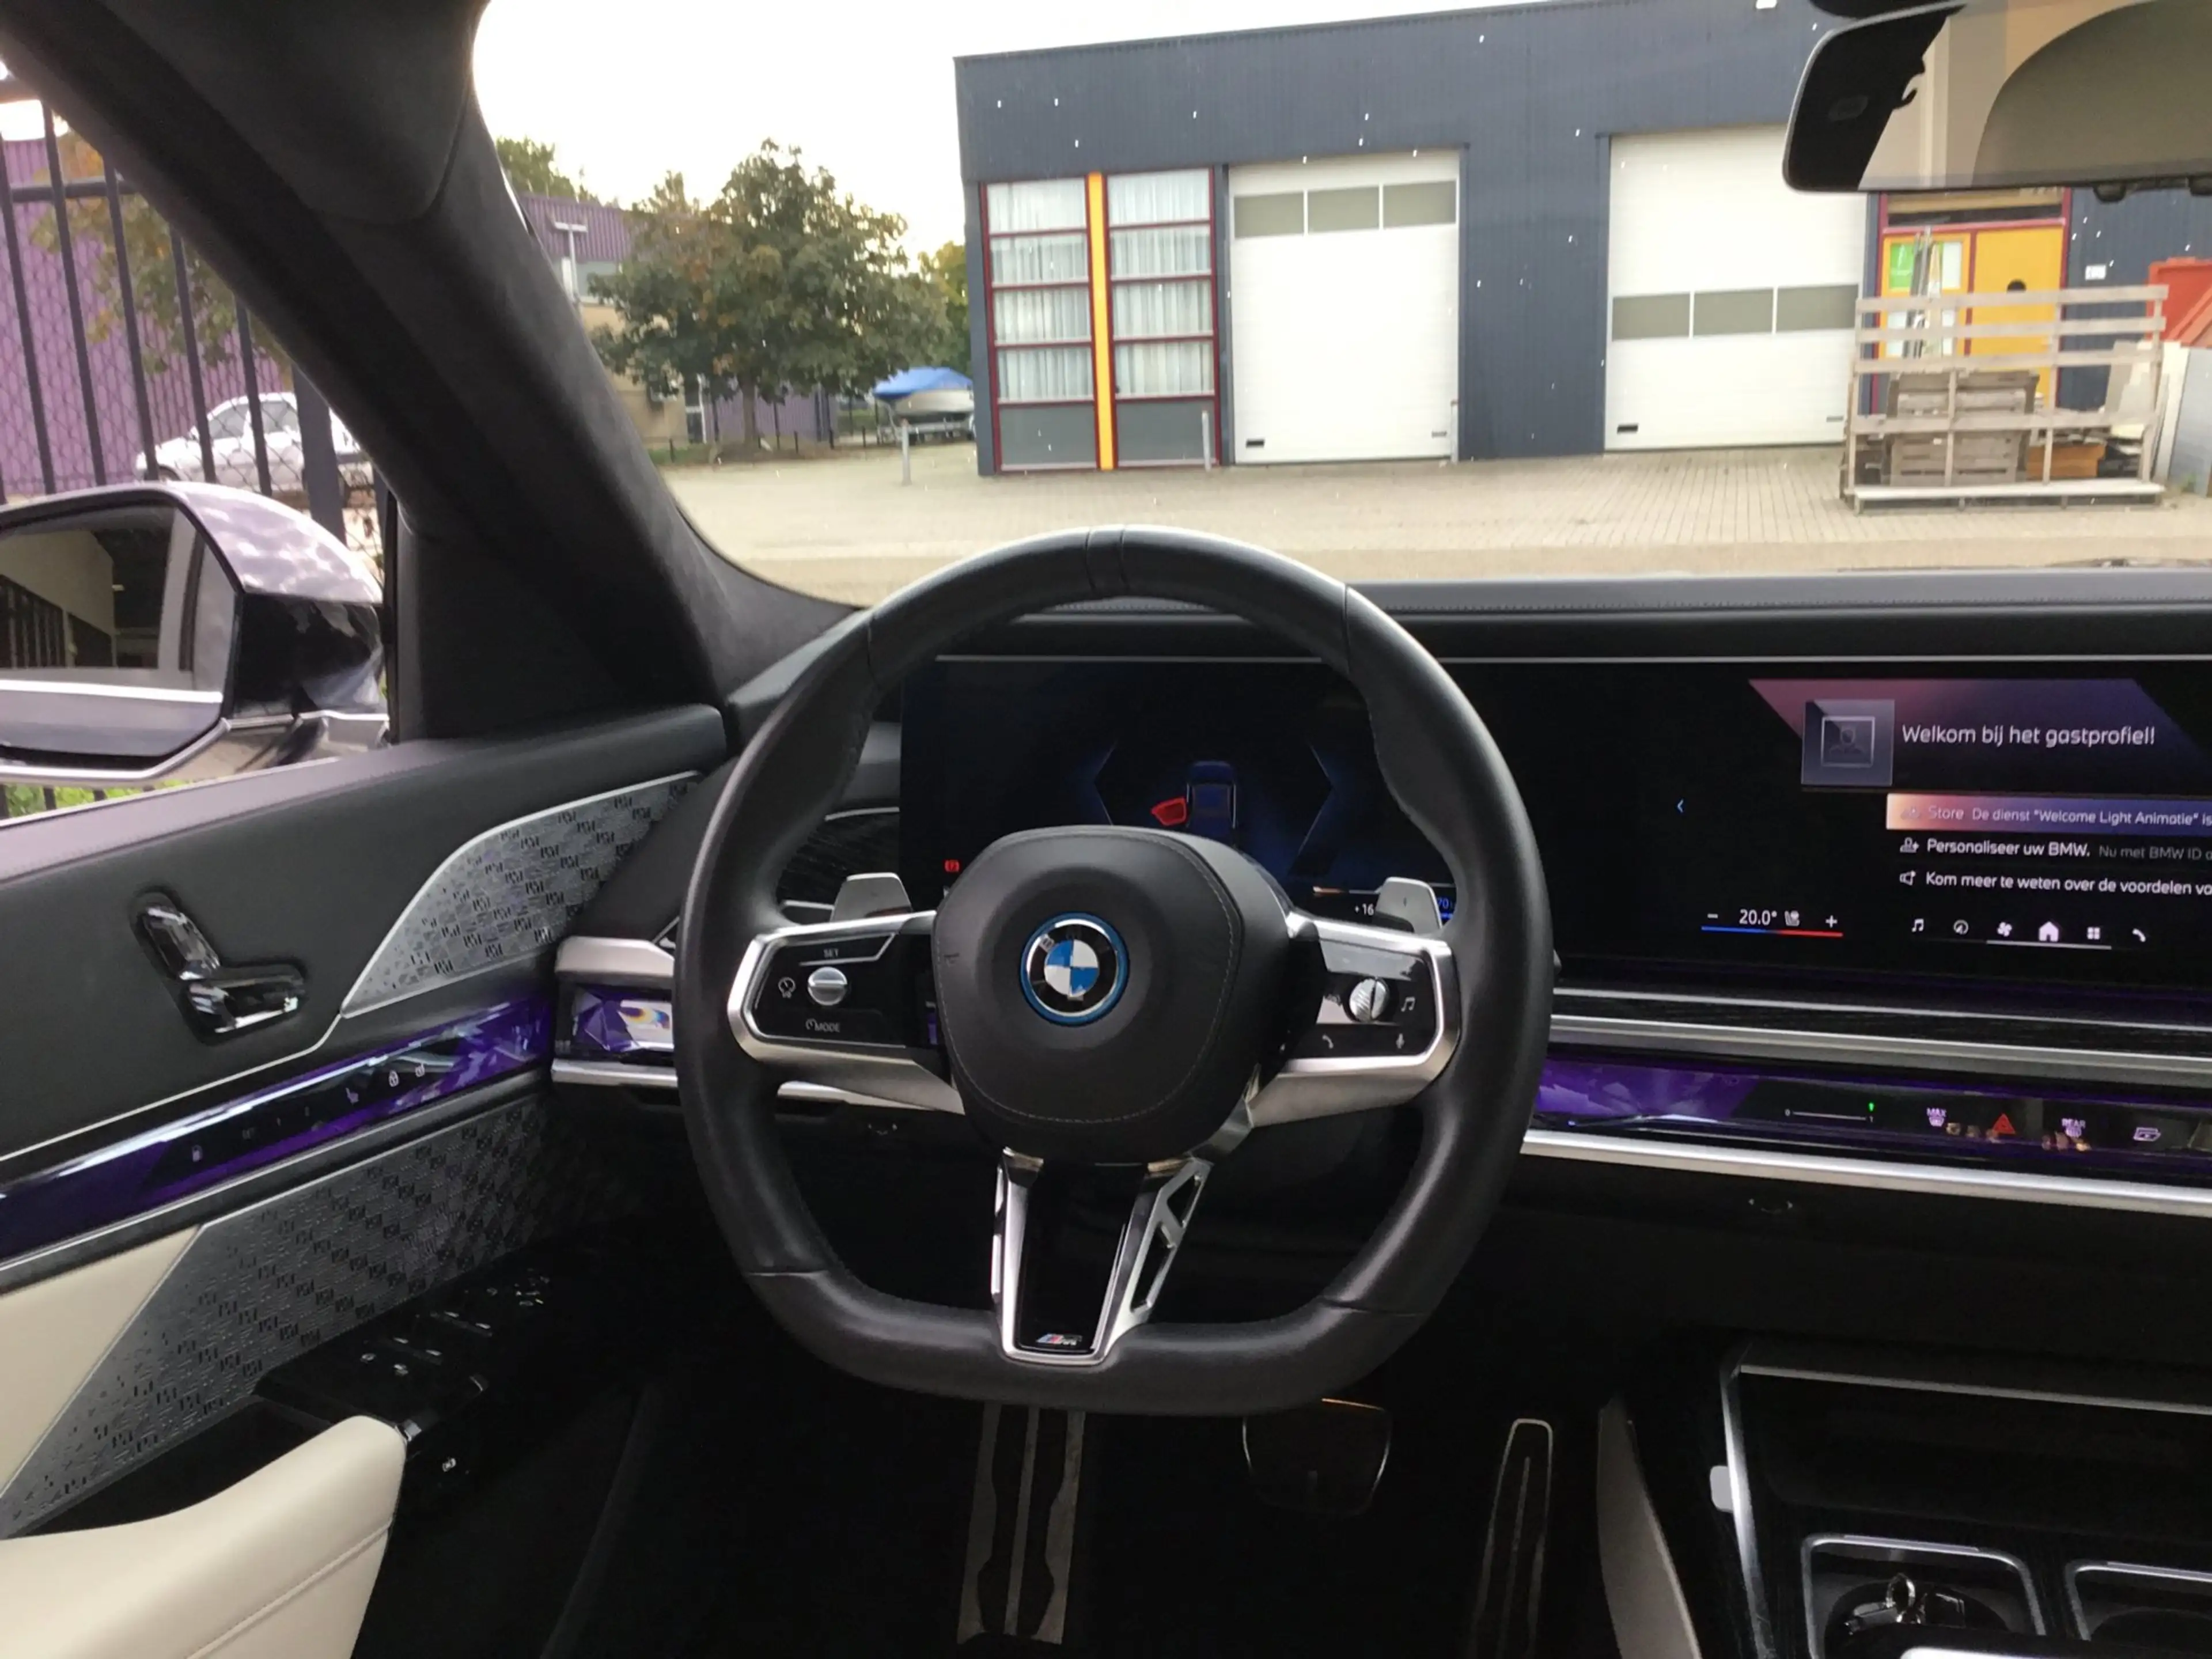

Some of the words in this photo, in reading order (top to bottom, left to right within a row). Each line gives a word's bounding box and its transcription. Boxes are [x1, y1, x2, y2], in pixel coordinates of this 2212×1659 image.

[1902, 725, 1976, 744] Welkom
[1982, 725, 2003, 747] bij
[2009, 725, 2040, 744] het
[2046, 726, 2154, 748] gastprofiel!
[1929, 806, 1964, 820] Store
[1972, 808, 1989, 821] De
[1993, 808, 2030, 821] dienst
[2034, 809, 2096, 823] "Welcome
[2100, 810, 2131, 826] Light
[2135, 811, 2199, 825] Animatie"
[1927, 838, 2020, 855] Personaliseer
[2023, 844, 2044, 855] uw
[2048, 841, 2090, 857] BMW.
[2099, 845, 2117, 858] Nu
[2120, 847, 2145, 858] met
[2149, 847, 2184, 859] BMW
[2188, 847, 2201, 860] ID
[1926, 872, 1957, 887] Kom
[1961, 876, 1997, 888] meer
[2001, 876, 2013, 888] te
[2017, 876, 2061, 890] weten
[2065, 879, 2095, 891] over
[2099, 878, 2116, 892] de
[2120, 879, 2191, 894] voordelen
